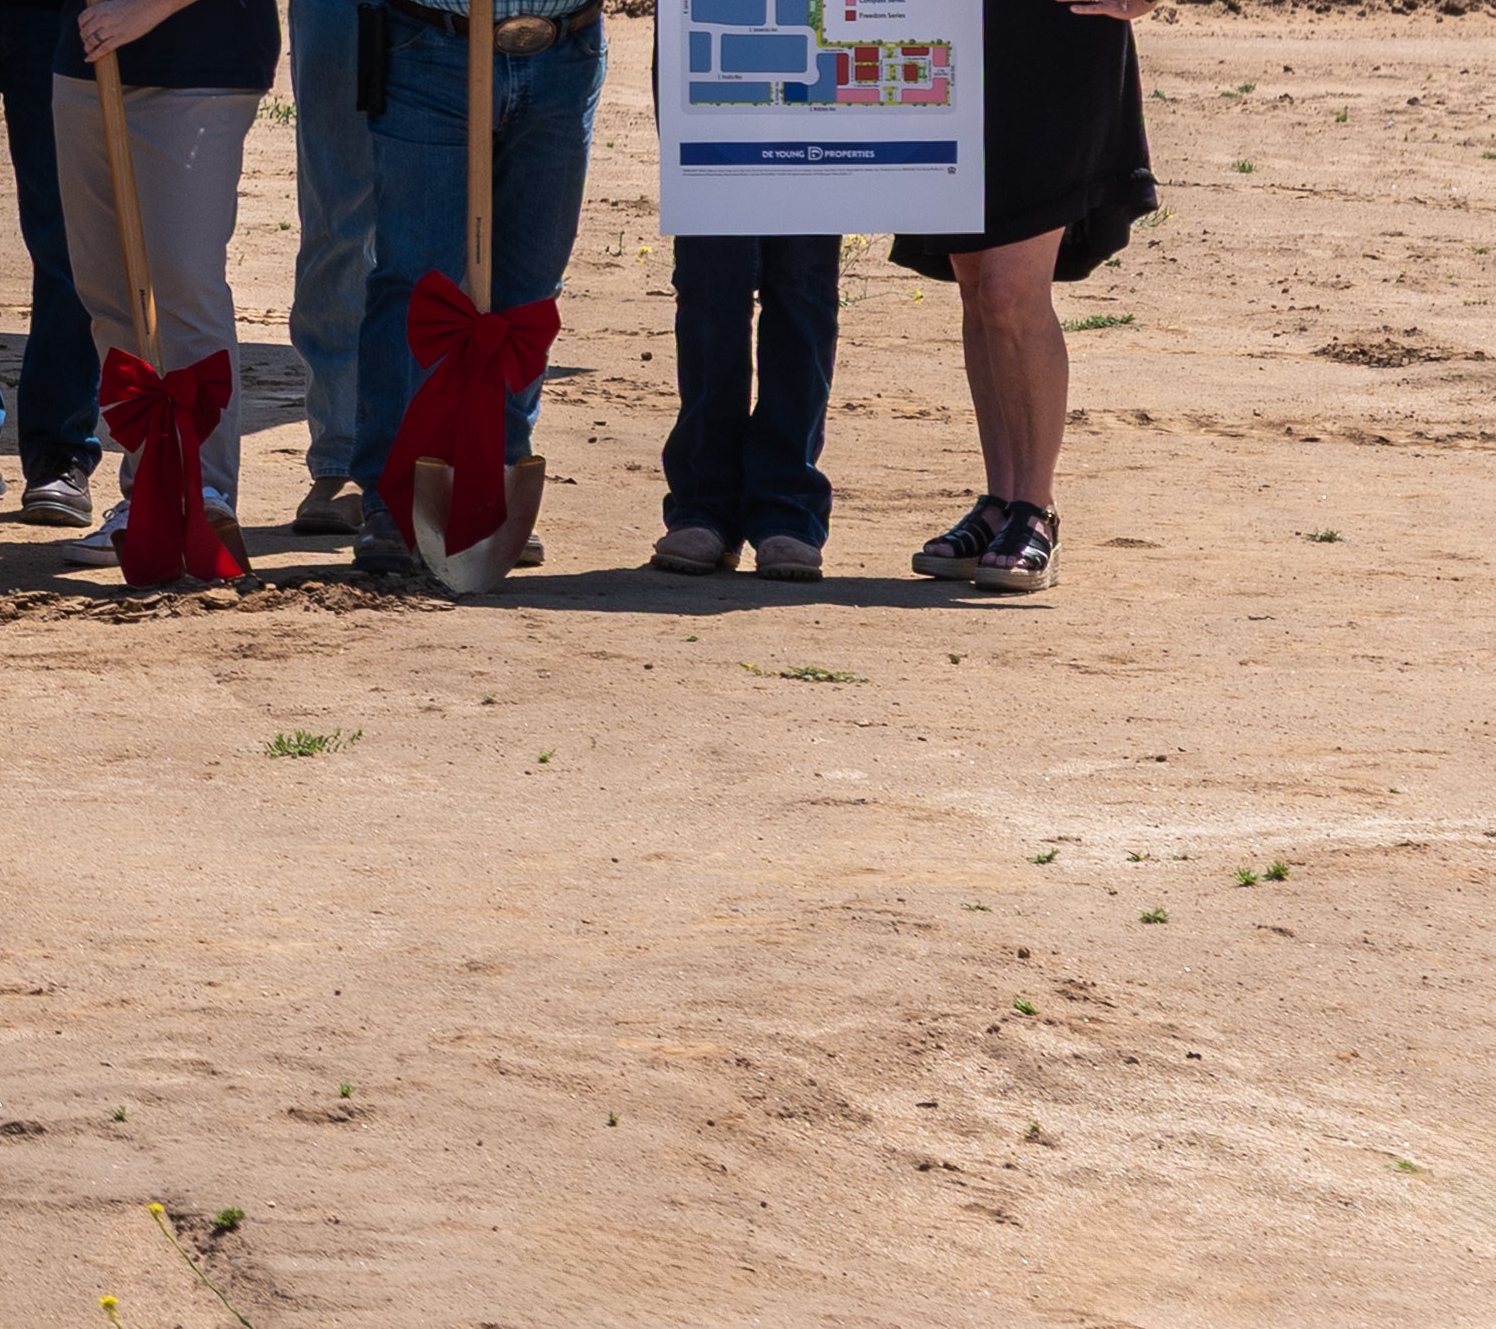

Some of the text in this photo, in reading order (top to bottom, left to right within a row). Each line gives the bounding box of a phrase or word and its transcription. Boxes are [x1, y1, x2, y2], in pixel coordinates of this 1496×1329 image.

[762, 150, 875, 158] DE YOUNG PROPERTIES
